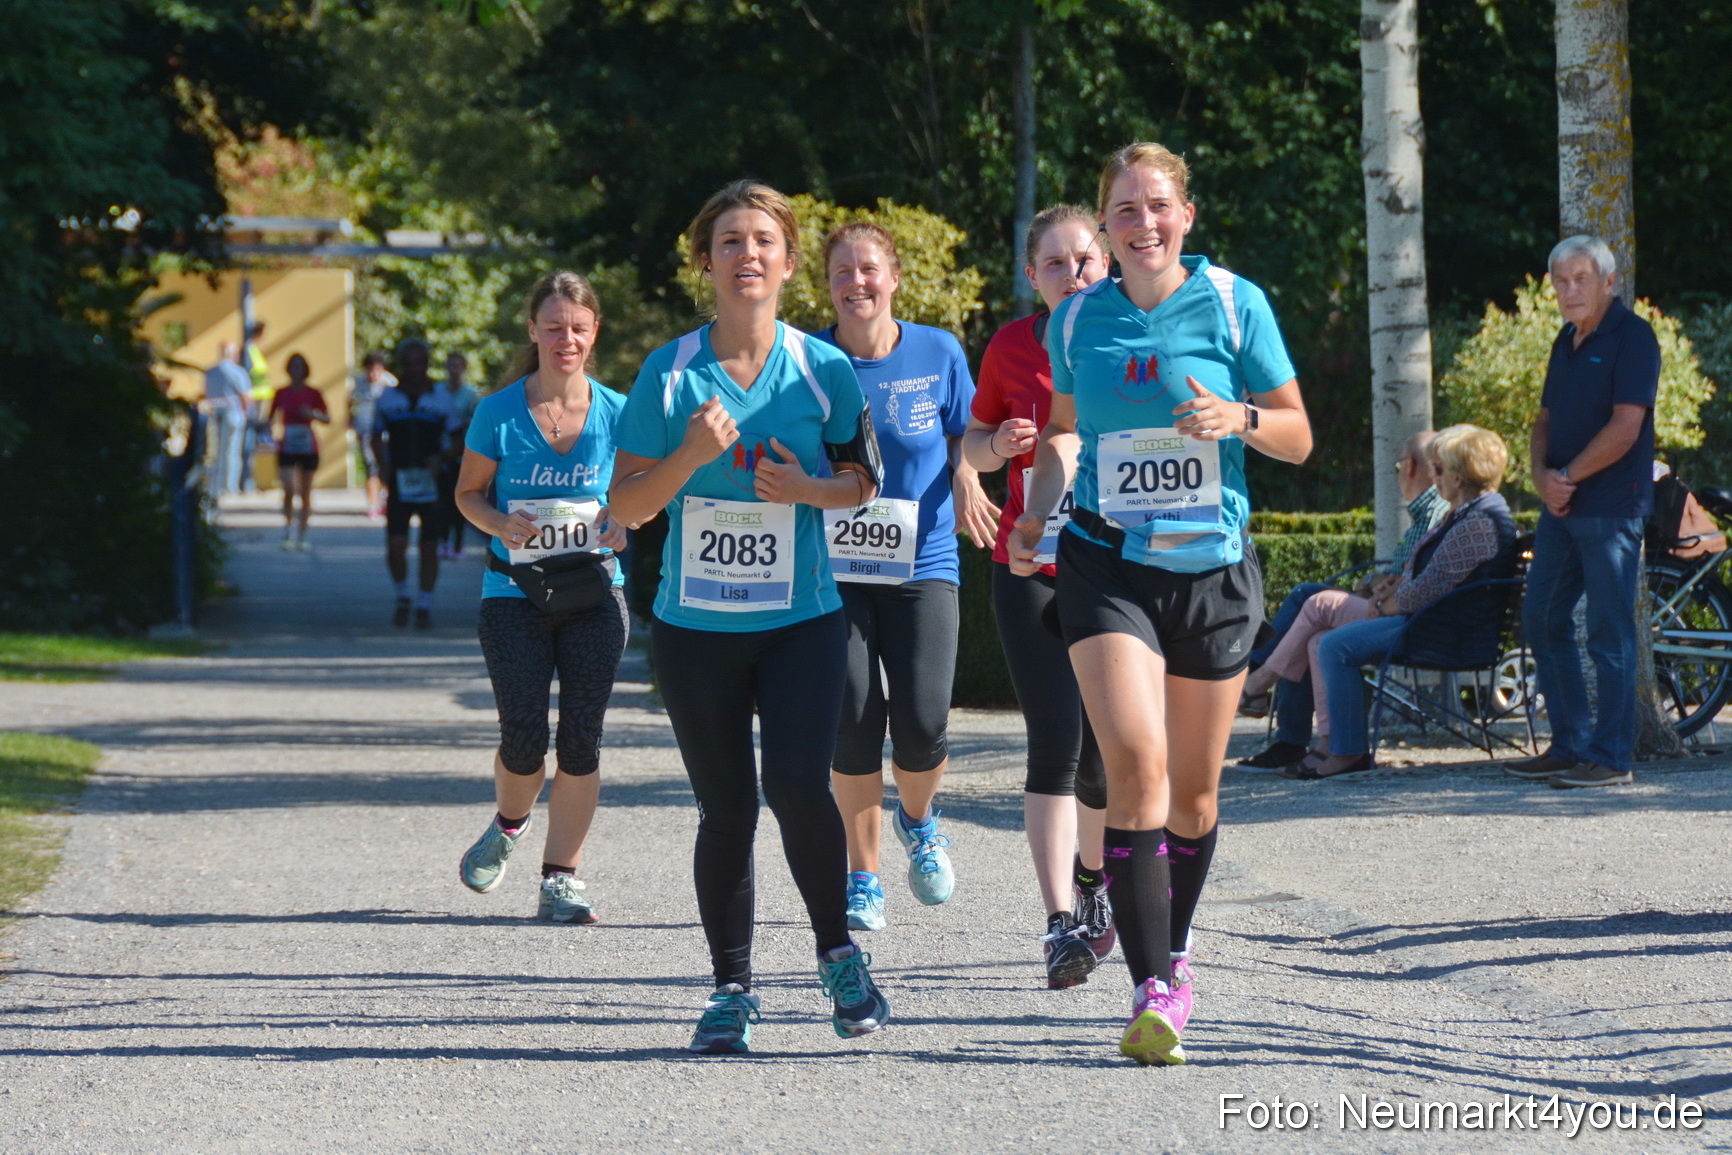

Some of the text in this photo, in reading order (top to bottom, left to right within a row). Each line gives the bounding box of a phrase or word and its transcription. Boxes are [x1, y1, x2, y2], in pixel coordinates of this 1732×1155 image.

[891, 375, 940, 387] NEUMARKTER
[890, 384, 930, 394] STADTLAUF
[1133, 438, 1185, 452] BOCK
[510, 463, 600, 487] ...läuft!
[1117, 457, 1203, 494] 2090
[1153, 496, 1188, 505] Neumarkt
[536, 507, 577, 517] BOCK
[714, 510, 763, 525] BOCK
[524, 522, 587, 550] 2010
[833, 520, 902, 550] 2999
[699, 530, 777, 566] 2083
[704, 568, 761, 579] PARTL Neumarkt
[850, 561, 881, 575] Birgit
[721, 585, 749, 600] Lisa
